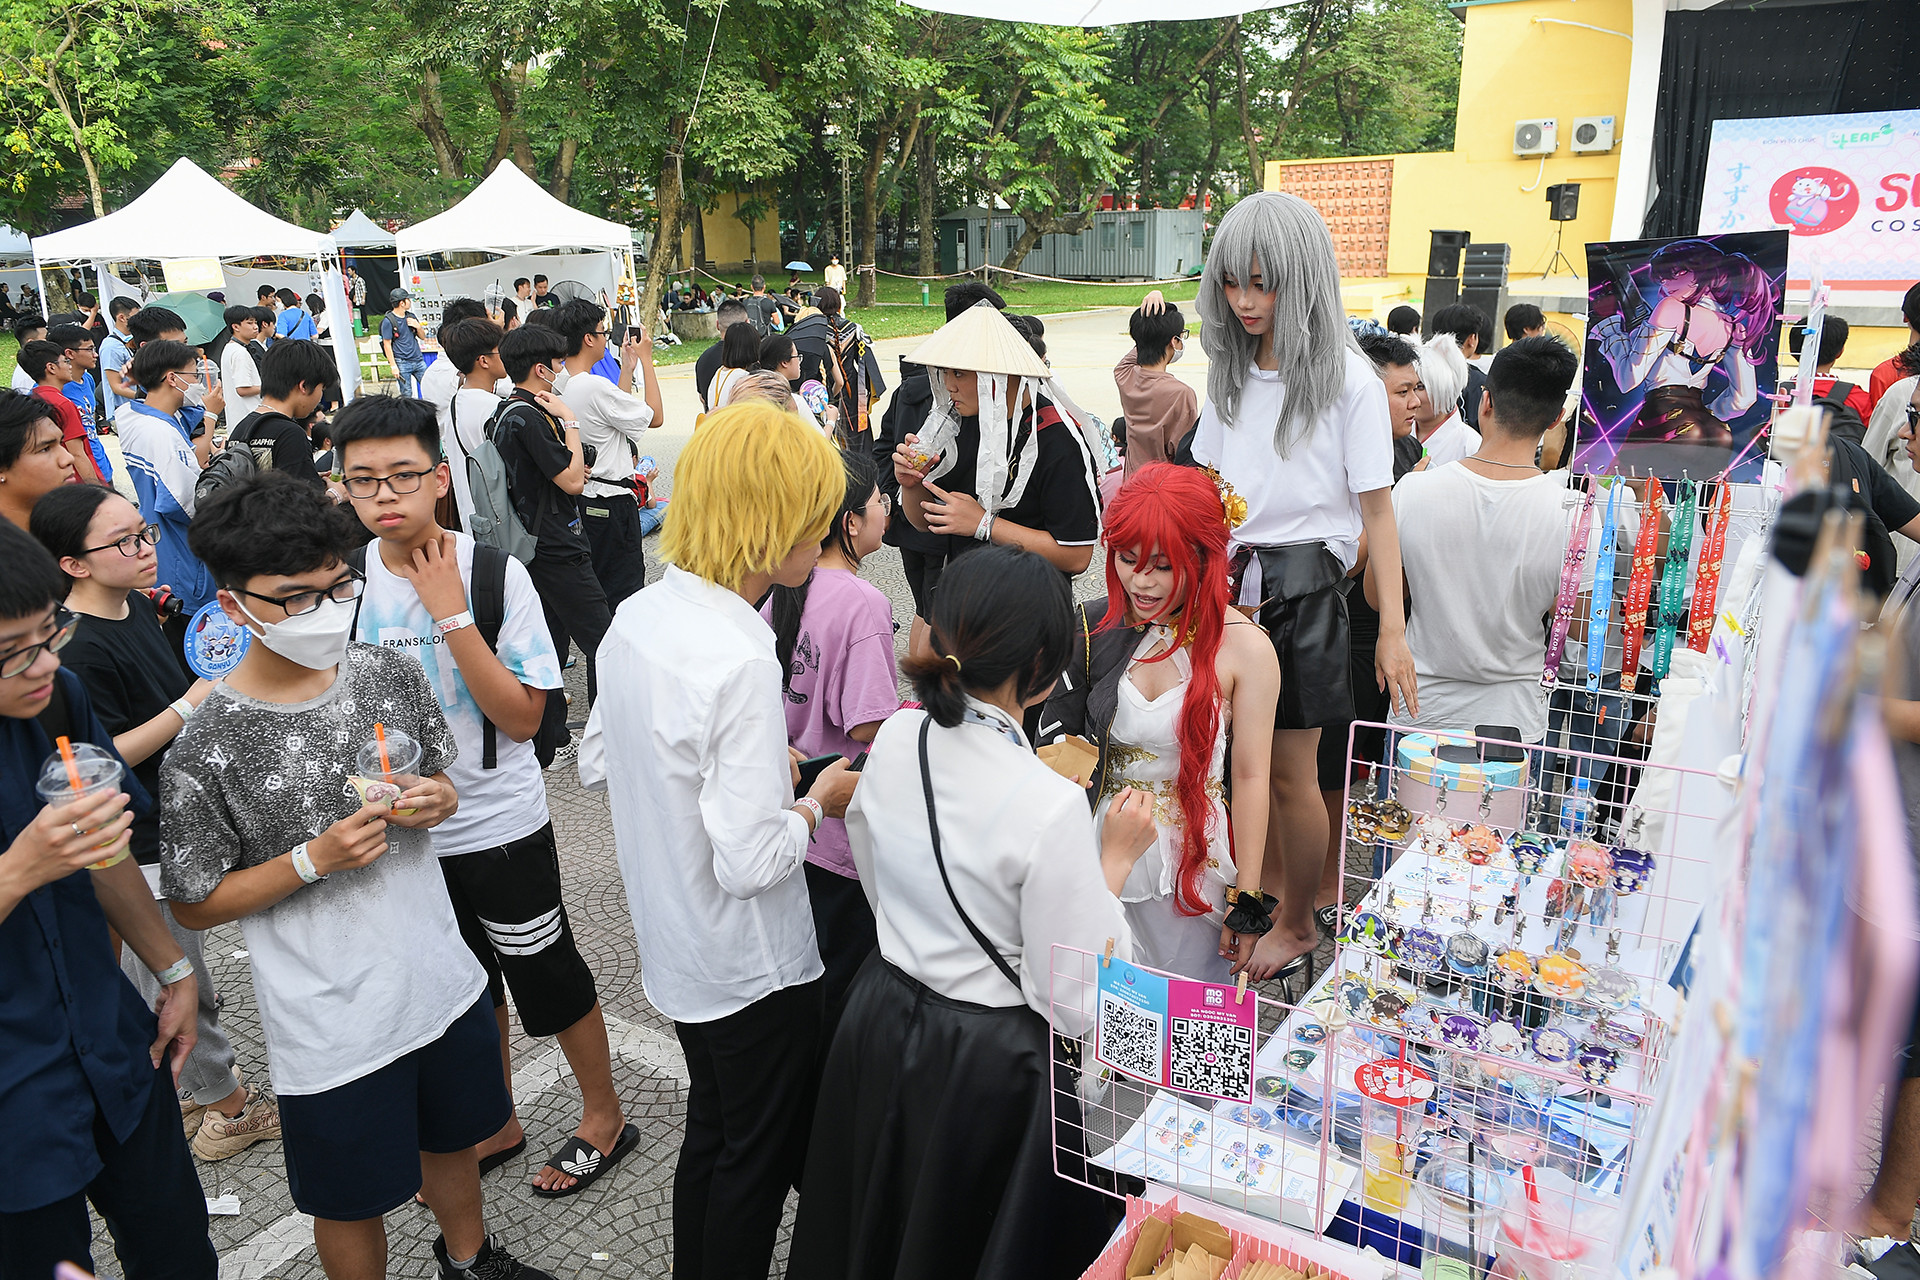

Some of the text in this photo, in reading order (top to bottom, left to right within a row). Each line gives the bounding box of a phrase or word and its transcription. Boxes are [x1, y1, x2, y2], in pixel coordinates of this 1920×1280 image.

[1841, 131, 1880, 146] LEAF
[1638, 578, 1648, 602] KAVEH
[1664, 570, 1673, 605] TIGHNARI
[1551, 628, 1560, 652] RAZOR
[1657, 634, 1667, 668] TIGHNARI
